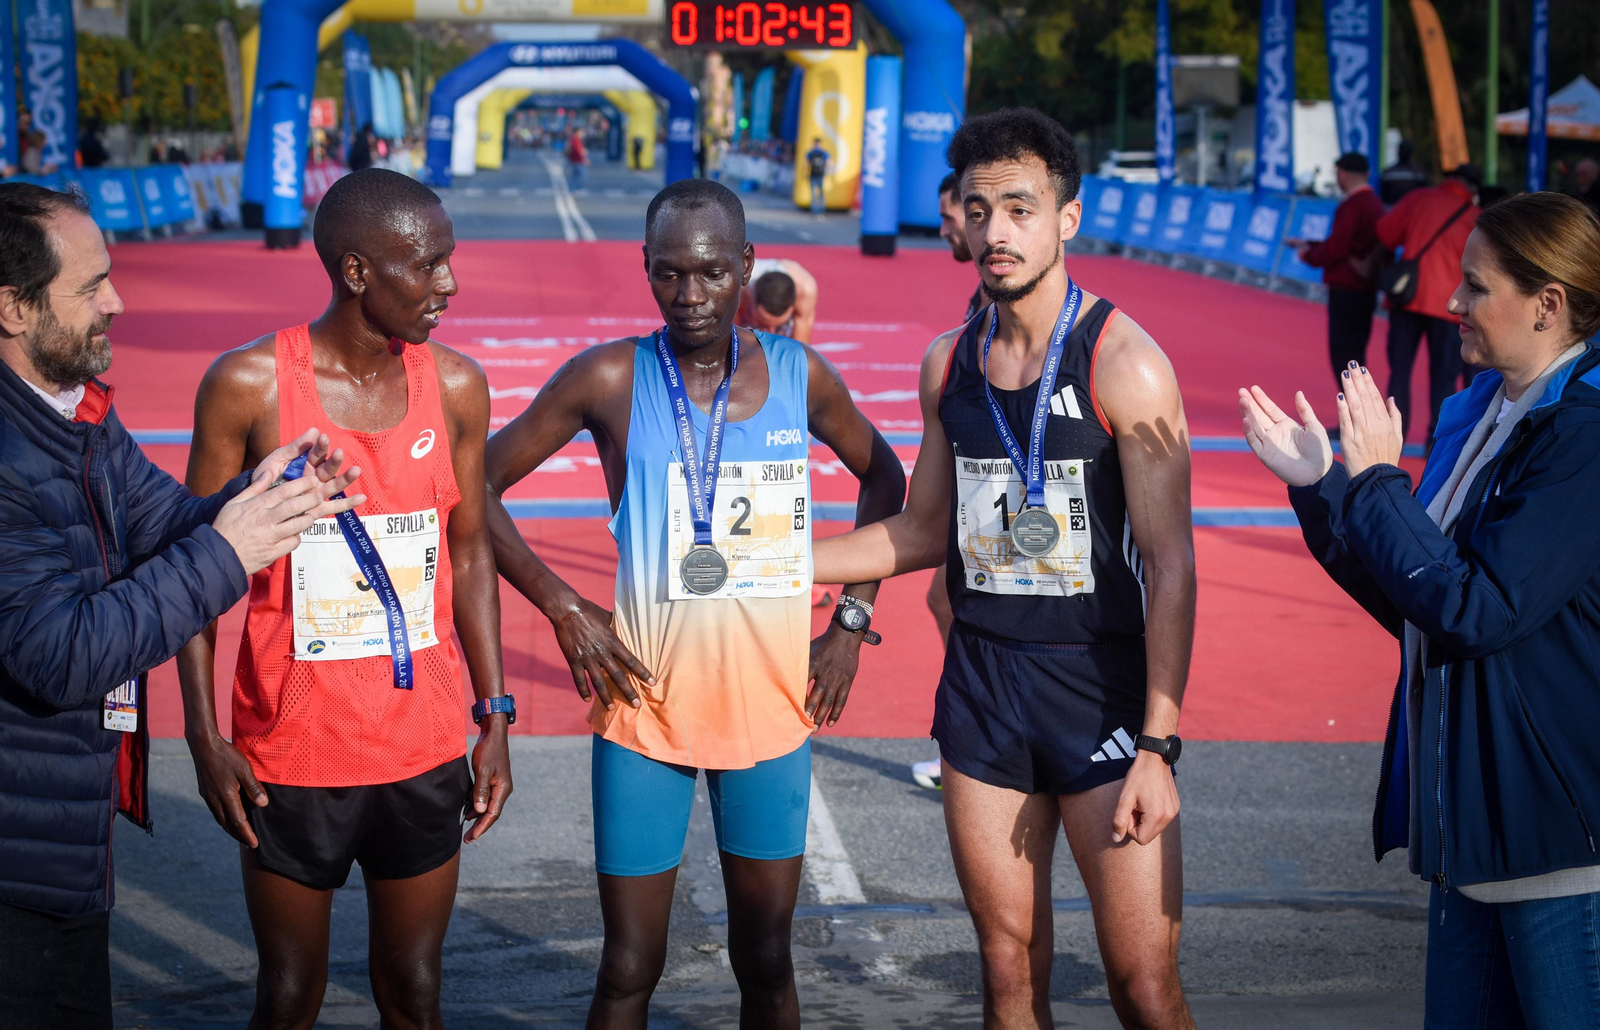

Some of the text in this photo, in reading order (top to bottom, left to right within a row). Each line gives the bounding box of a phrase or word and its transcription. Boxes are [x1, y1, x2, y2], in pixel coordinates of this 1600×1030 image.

[672, 2, 851, 47] 0 1:02:43
[904, 111, 955, 133] HOKA
[1259, 43, 1290, 190] HOKA
[273, 120, 297, 198] HOKA
[863, 108, 887, 188] HOKA
[1055, 322, 1068, 345] MEDIO
[1063, 294, 1078, 323] MARATÓN
[667, 366, 679, 388] MEDIO
[713, 400, 724, 424] MEDIO
[1032, 356, 1058, 481] MEDIO MARATÓN DE SEVILLA 2024
[709, 425, 721, 462] MARATÓN
[766, 429, 803, 447] HOKA
[991, 403, 1008, 436] MARATÓN
[1005, 436, 1014, 447] DE
[1010, 447, 1028, 477] SEVILLA
[675, 397, 705, 521] MEDIO MARATÓN DE SEVILLA 2024
[705, 462, 715, 474] DE
[963, 461, 1014, 476] MEDIO MARATÓN
[716, 464, 795, 481] RATÓN SEVILLA
[387, 513, 425, 534] SEVILLA
[729, 496, 752, 536] 2
[994, 493, 1010, 532] 1
[357, 536, 370, 555] 2024
[297, 566, 305, 591] ELITE
[373, 563, 389, 588] MEDIO
[735, 580, 754, 590] HOKA
[1015, 578, 1034, 586] HOKA
[384, 589, 402, 633] MARATÓN
[362, 637, 384, 647] HOKA
[393, 631, 404, 642] DE
[395, 643, 408, 678] SEVILLA
